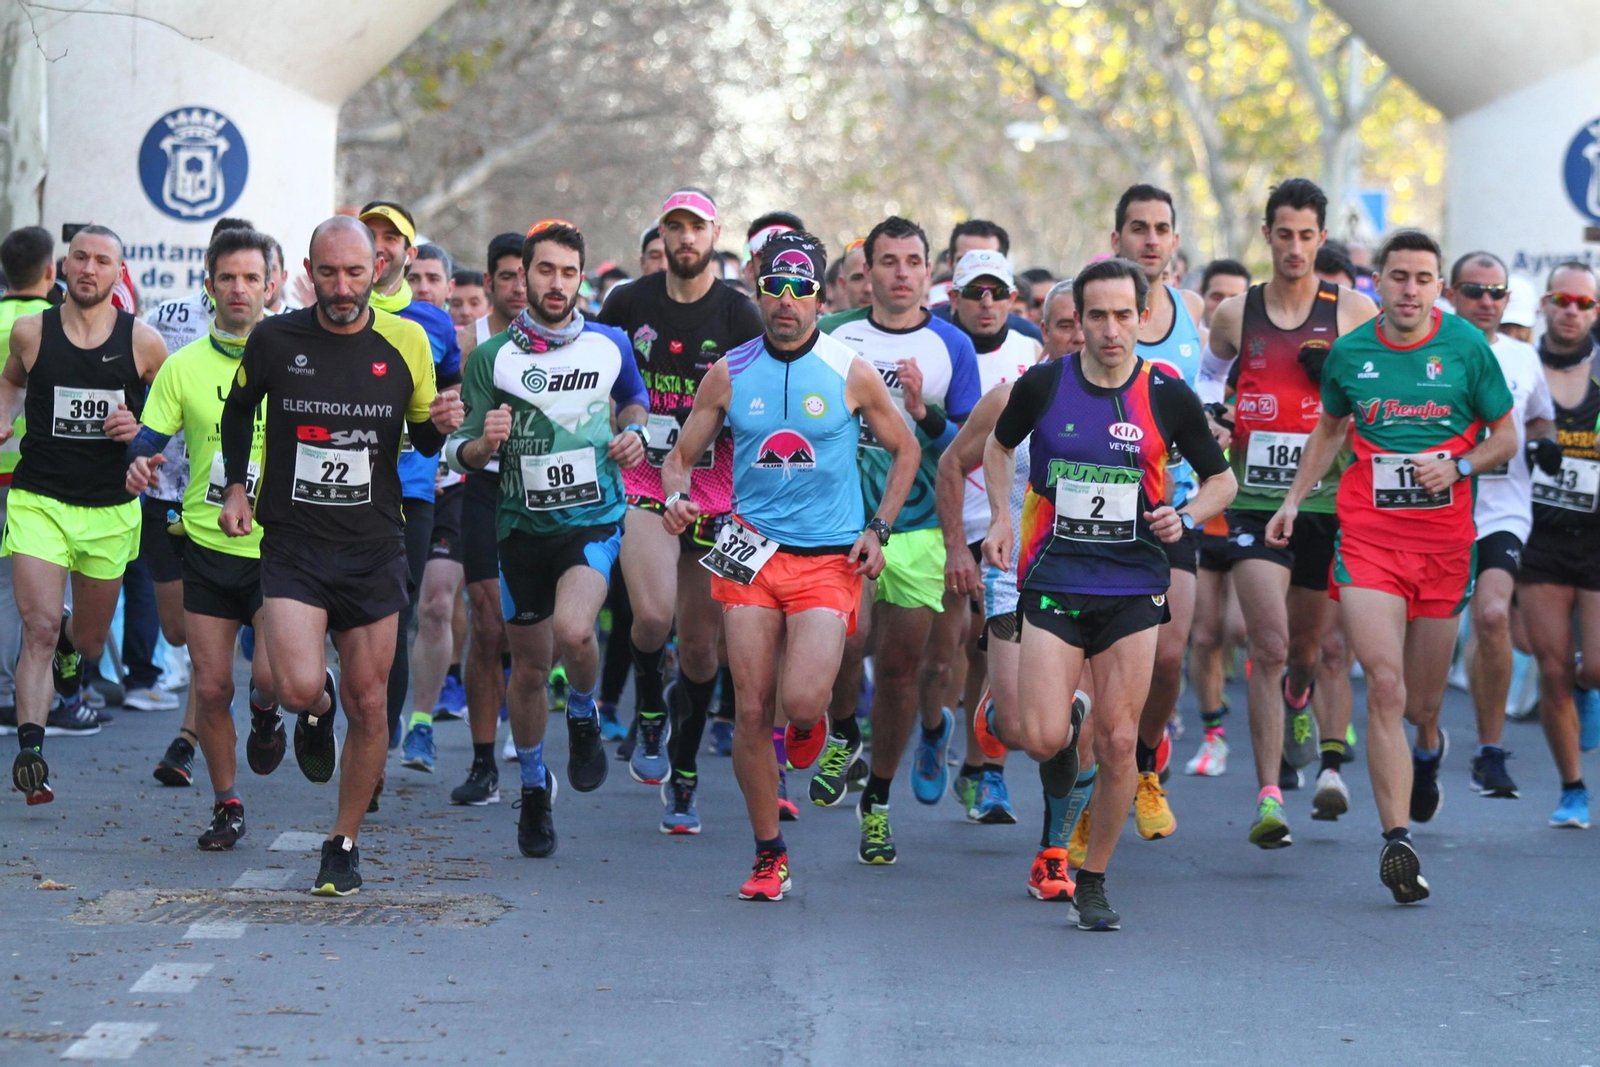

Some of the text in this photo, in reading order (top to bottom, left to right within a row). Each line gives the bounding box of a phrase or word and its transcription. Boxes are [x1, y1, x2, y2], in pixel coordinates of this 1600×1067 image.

[122, 242, 207, 260] untam
[141, 267, 206, 289] de H
[287, 365, 315, 375] Vegenat
[547, 369, 599, 392] adm
[70, 399, 109, 419] 399
[283, 398, 393, 418] ELEKTROKAMYR
[511, 409, 537, 437] AZ
[1114, 425, 1139, 439] KIA
[296, 425, 379, 446] BSM
[1109, 441, 1141, 454] VEYSER
[1267, 445, 1301, 467] 184
[320, 461, 349, 484] 22
[547, 464, 575, 488] 98
[1395, 466, 1423, 488] 11
[1096, 486, 1104, 495] VI
[1090, 496, 1105, 519] 2
[721, 534, 757, 562] 370
